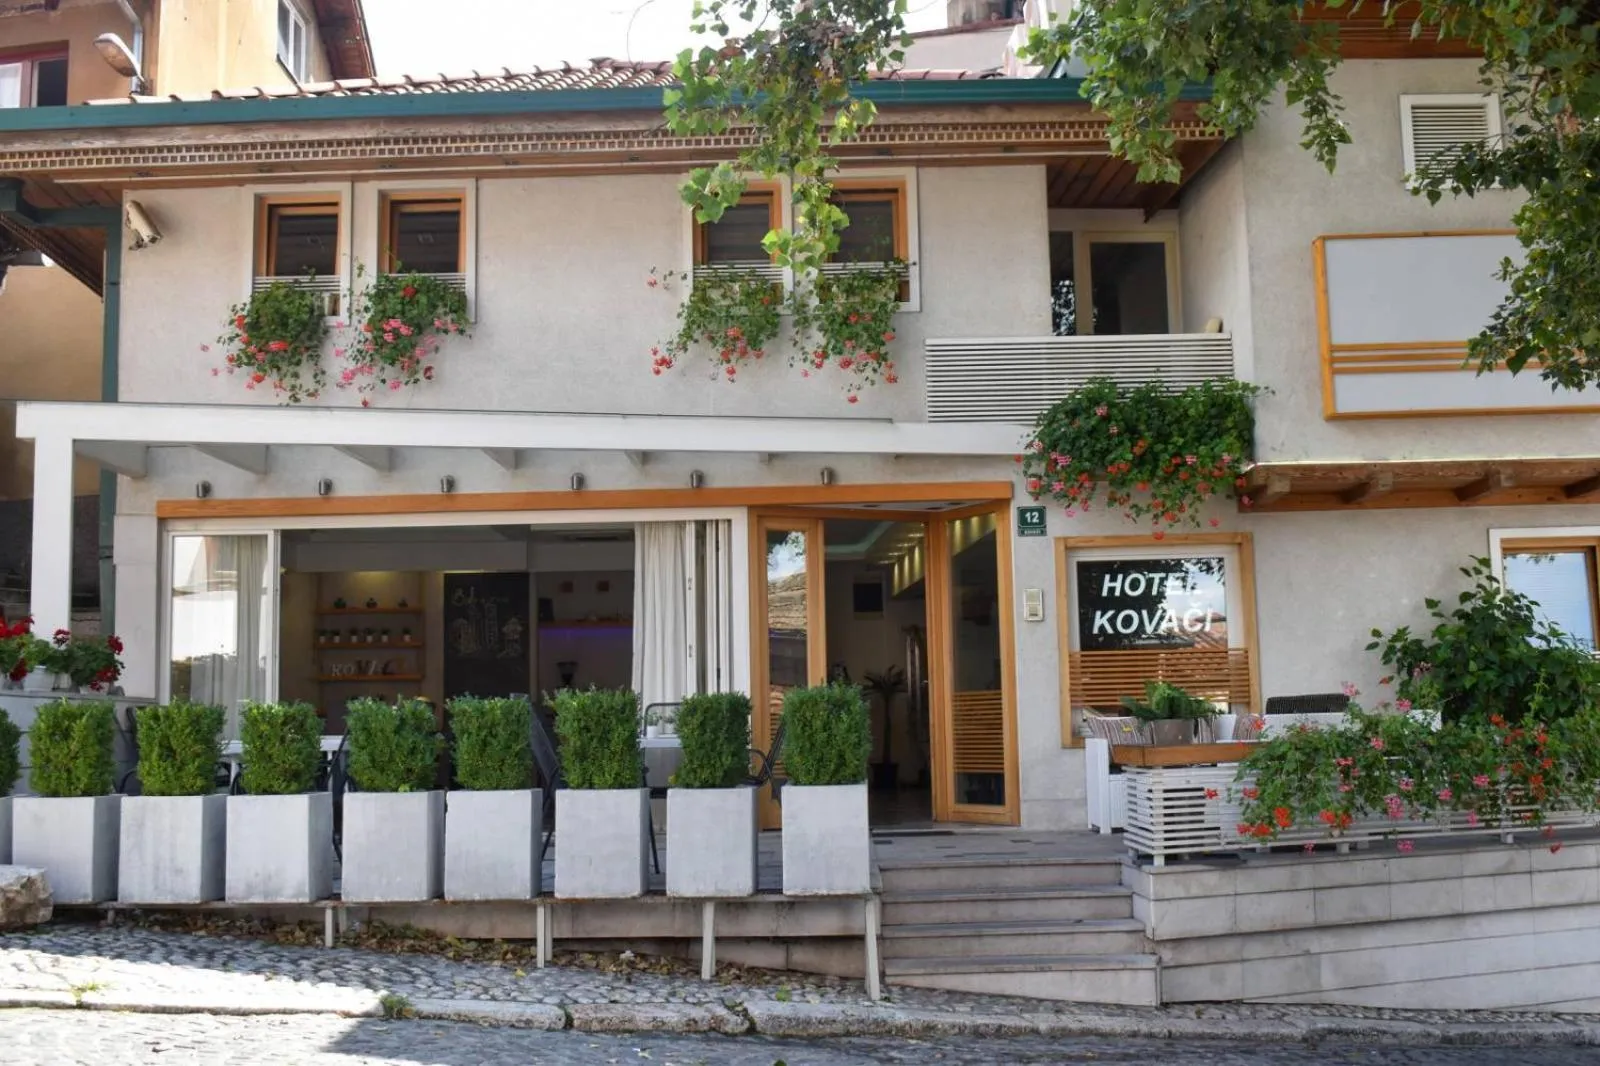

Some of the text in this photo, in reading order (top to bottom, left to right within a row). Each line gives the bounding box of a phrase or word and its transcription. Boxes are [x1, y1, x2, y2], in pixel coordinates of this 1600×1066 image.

[1025, 511, 1039, 523] 12
[1101, 572, 1202, 597] HOTEL
[1092, 603, 1214, 635] KOVAČI
